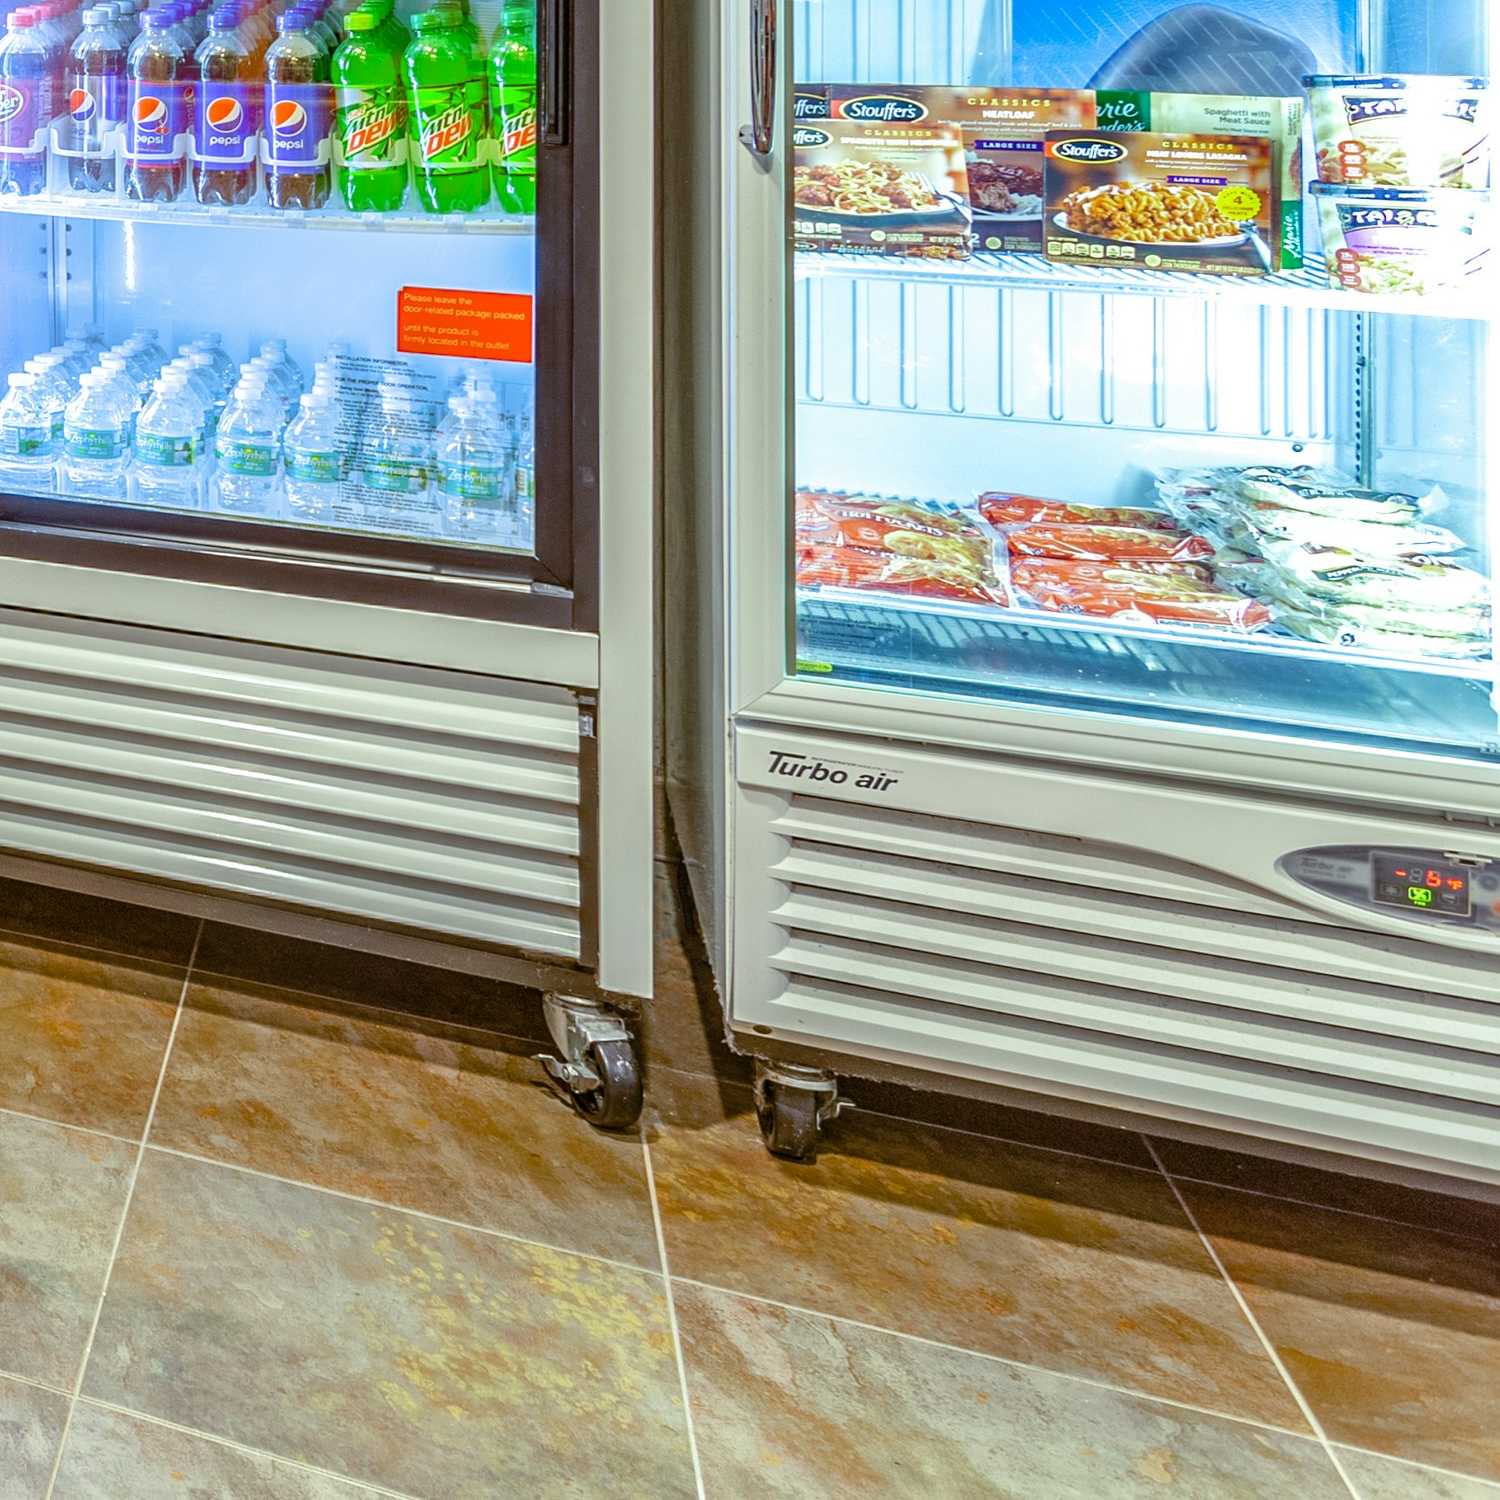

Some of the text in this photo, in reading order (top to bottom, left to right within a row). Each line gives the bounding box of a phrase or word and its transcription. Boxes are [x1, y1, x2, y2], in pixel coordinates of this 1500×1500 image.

[967, 97, 1052, 107] CLASSICS
[849, 100, 917, 120] Stouffer's
[982, 109, 1036, 120] MEATLOAF
[1204, 107, 1272, 120] Spaghetti with
[1218, 115, 1272, 127] Meat Sauce
[864, 129, 933, 138] CLASSICS
[135, 134, 164, 146] pepsi
[209, 134, 241, 147] pepsi
[273, 138, 304, 151] pepsi
[982, 140, 1038, 150] LARGE SIZE
[1161, 141, 1234, 151] CLASSICS
[1059, 142, 1119, 160] Stouffer's
[1207, 151, 1248, 162] LASAGNA
[1172, 176, 1222, 186] LARGE SIZE
[1232, 196, 1243, 206] 4
[403, 293, 472, 306] Please leave the
[455, 308, 526, 321] package packed
[403, 324, 422, 332] until
[423, 325, 436, 333] the
[438, 327, 470, 337] product
[403, 335, 510, 350] firmly located in the outlet
[359, 378, 380, 386] PROPER
[223, 445, 271, 461] Zephyrhills
[768, 750, 848, 784] Turbo
[854, 772, 898, 791] air
